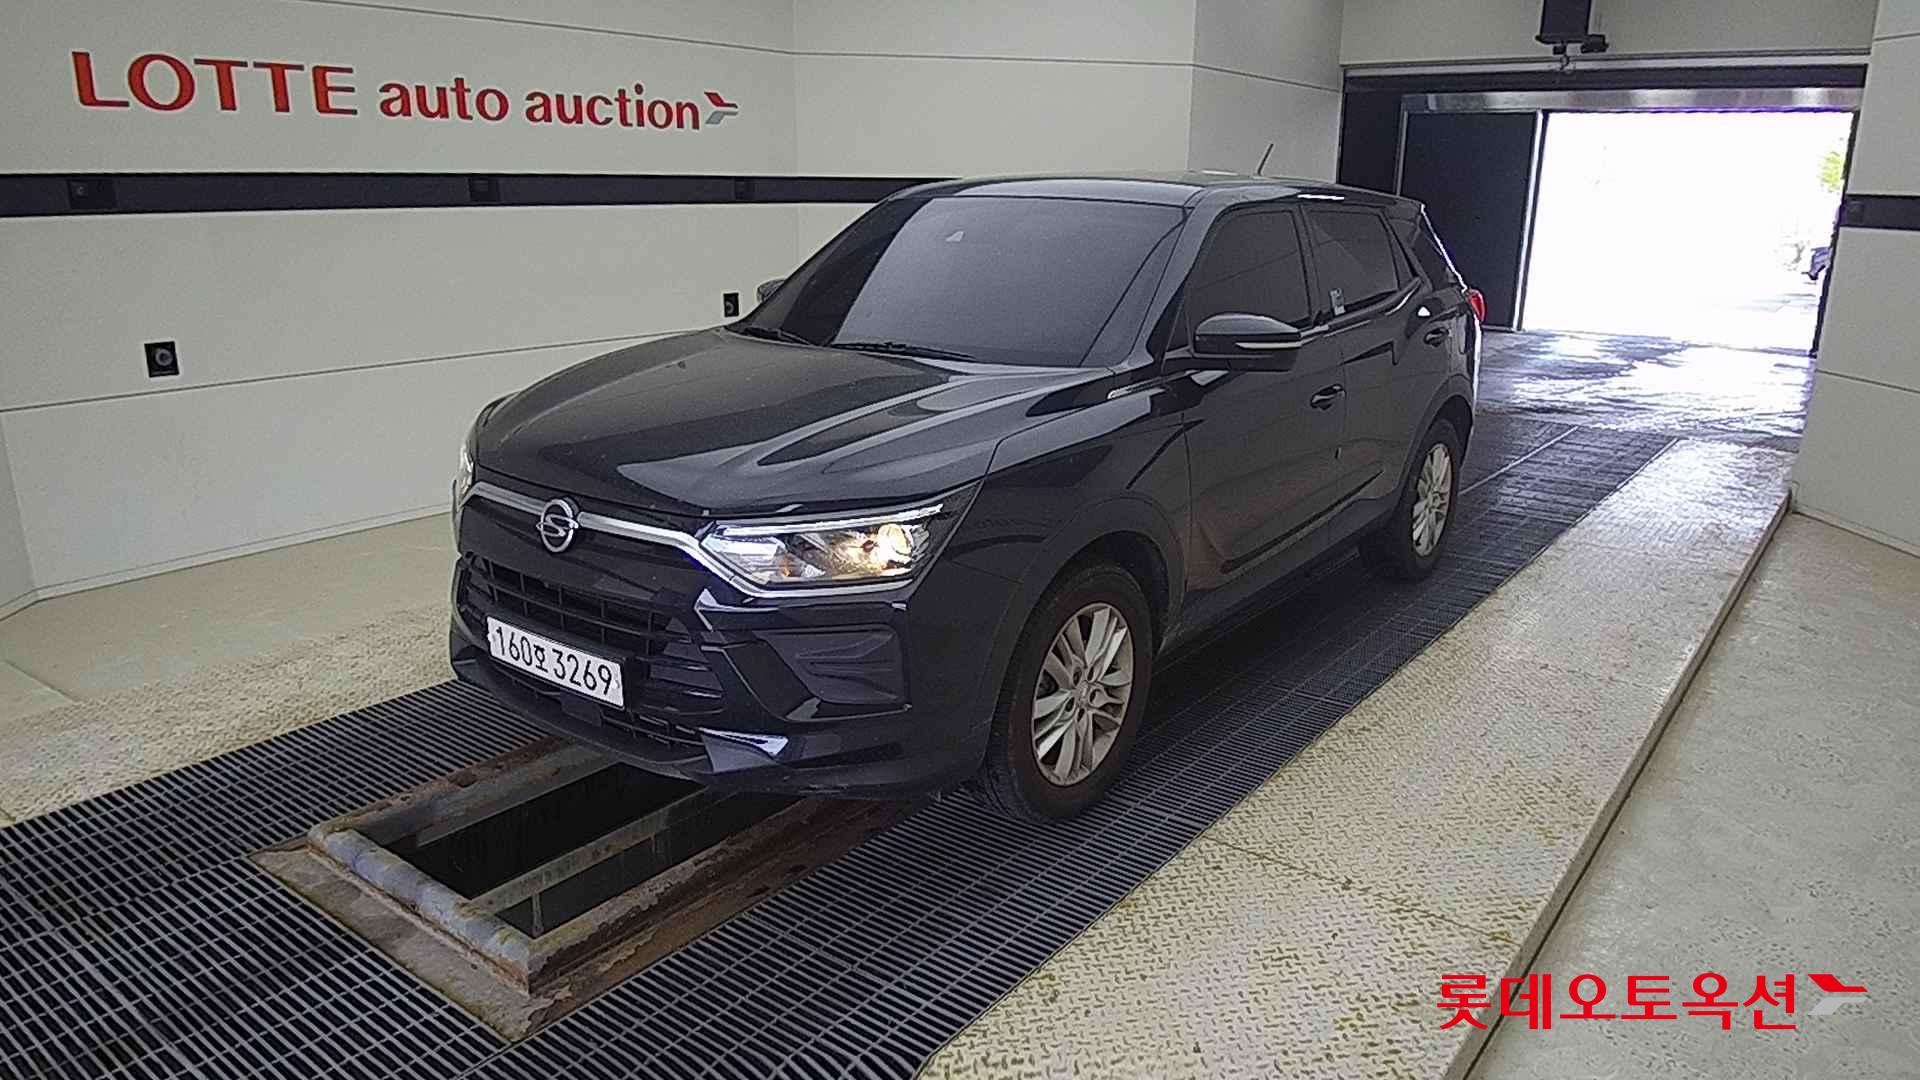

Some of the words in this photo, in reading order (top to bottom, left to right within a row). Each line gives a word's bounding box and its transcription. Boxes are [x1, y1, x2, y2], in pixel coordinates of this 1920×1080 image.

[72, 51, 358, 116] LOTTE
[379, 77, 509, 123] auto
[525, 84, 700, 130] auction
